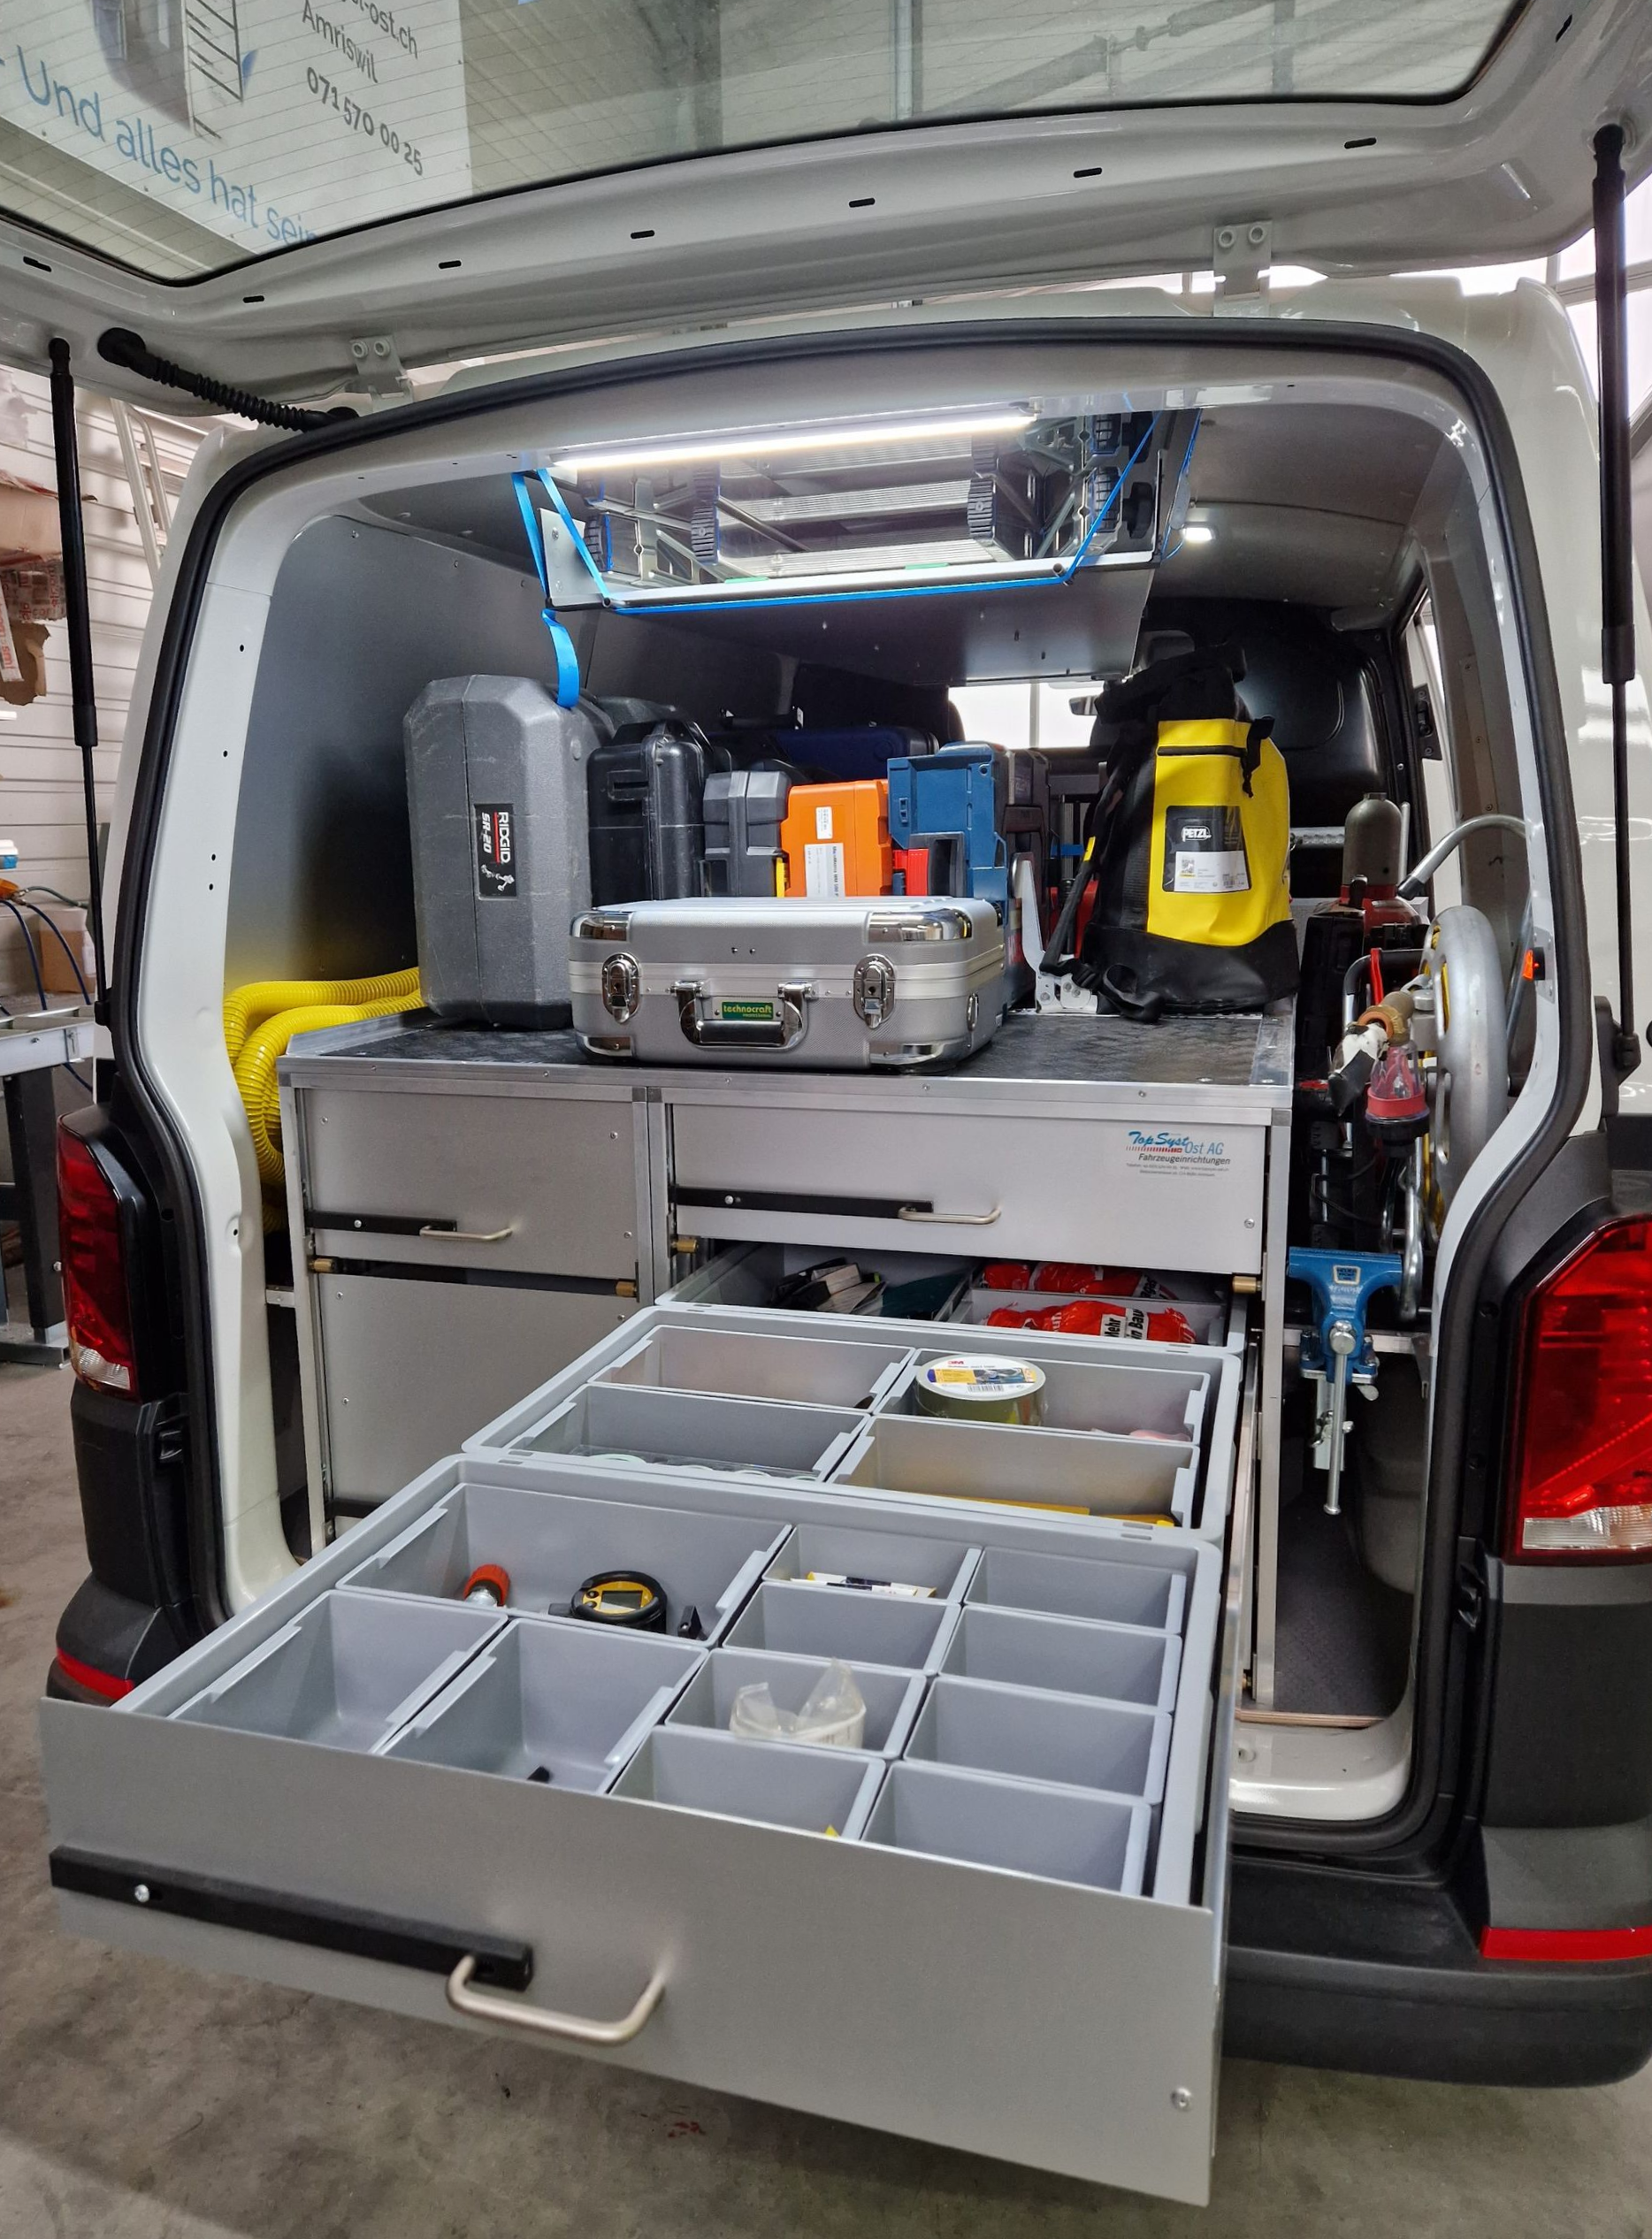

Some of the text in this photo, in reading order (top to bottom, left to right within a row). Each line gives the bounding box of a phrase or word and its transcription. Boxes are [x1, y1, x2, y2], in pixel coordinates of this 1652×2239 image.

[302, 0, 379, 83] Amriswil
[17, 44, 106, 142] Und
[116, 118, 201, 195] alles
[209, 159, 258, 228] hat
[307, 66, 423, 176] 071 570 00 25
[498, 811, 511, 864] RIDGID
[1181, 826, 1212, 842] PETZL
[723, 1005, 772, 1013] technocraft
[1138, 1153, 1231, 1165] Fahrzeugeinrichtungen
[1184, 1141, 1205, 1155] Ost
[1207, 1142, 1225, 1156] AG
